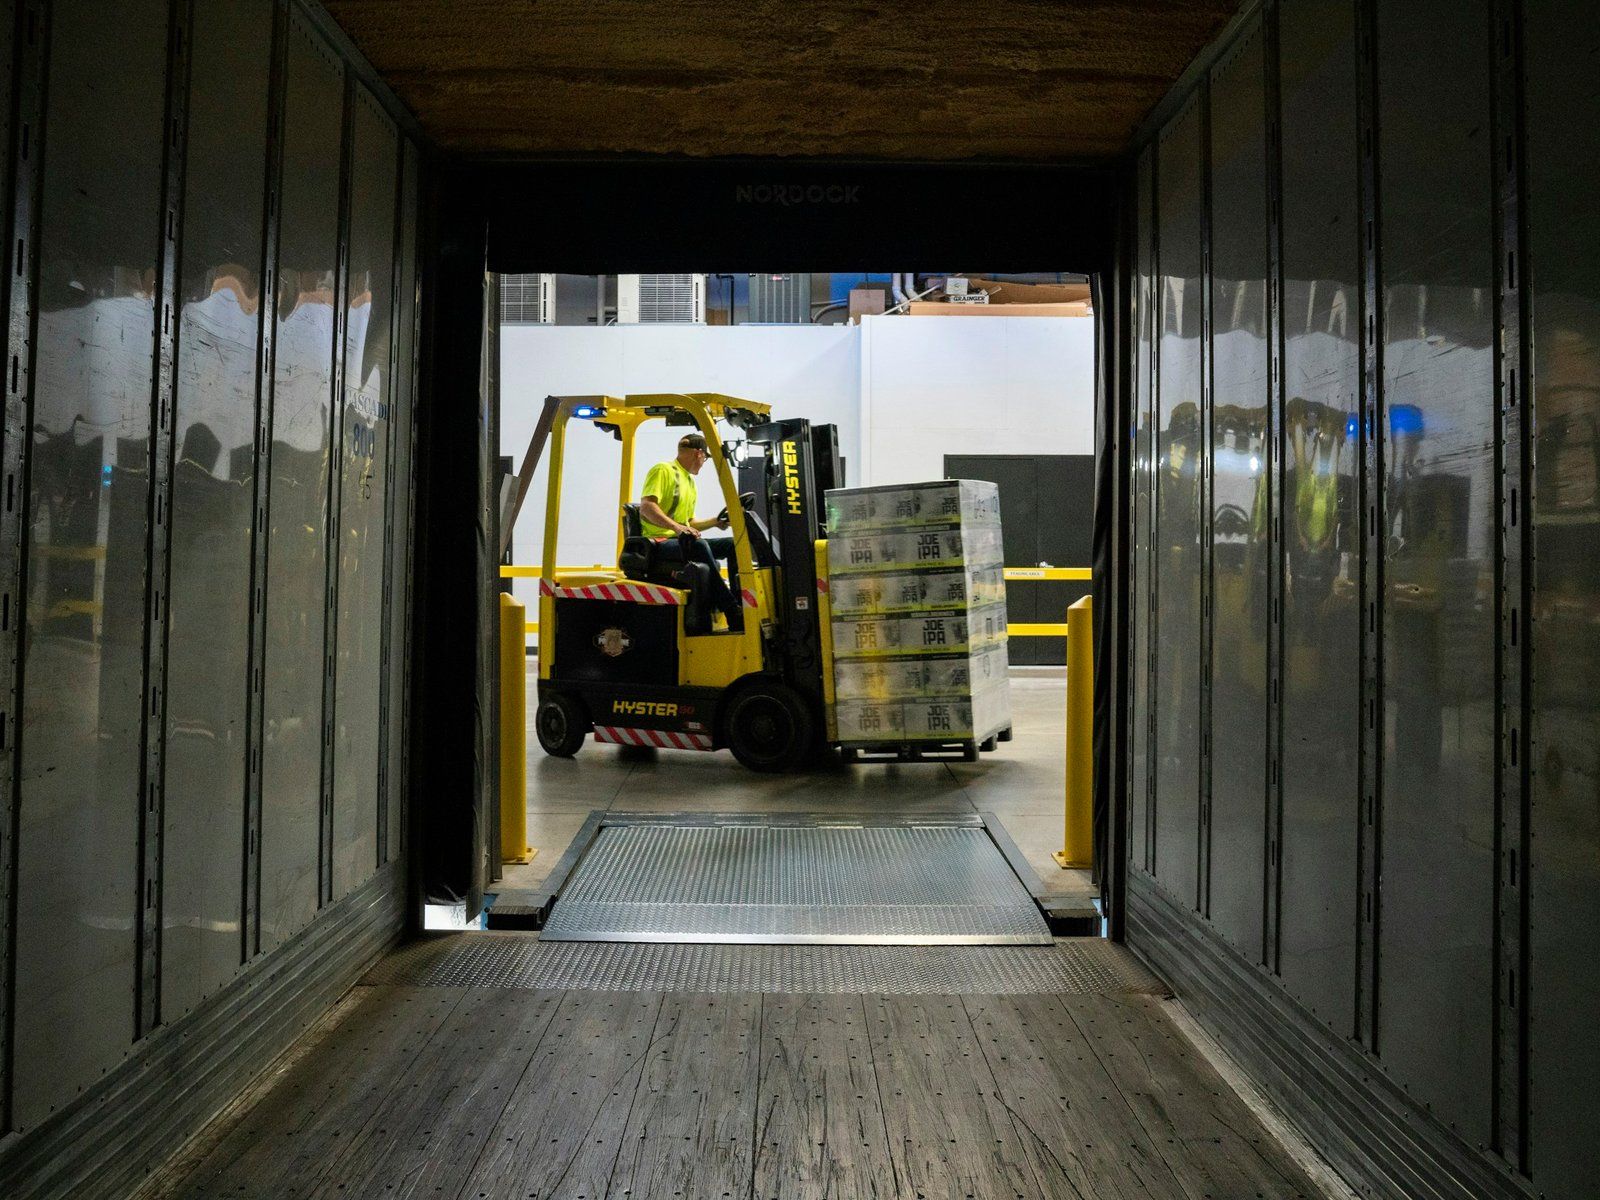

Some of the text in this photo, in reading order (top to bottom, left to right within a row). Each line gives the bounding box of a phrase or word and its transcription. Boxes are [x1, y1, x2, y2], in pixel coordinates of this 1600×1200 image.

[735, 184, 861, 206] NORDOCK
[782, 440, 801, 515] HYSTER
[851, 538, 871, 550] JOE
[917, 534, 939, 545] JOE
[851, 550, 872, 564] IPA
[918, 545, 940, 559] IPA
[948, 591, 964, 601] IPA
[855, 622, 876, 634] JOE
[923, 619, 944, 631] JOE
[855, 634, 877, 649] IPA
[923, 631, 946, 645] IPA
[612, 700, 678, 717] HYSTER
[859, 706, 880, 718] JOE
[927, 705, 950, 716] JOE
[860, 718, 880, 732] IPA
[928, 716, 950, 730] IPA
